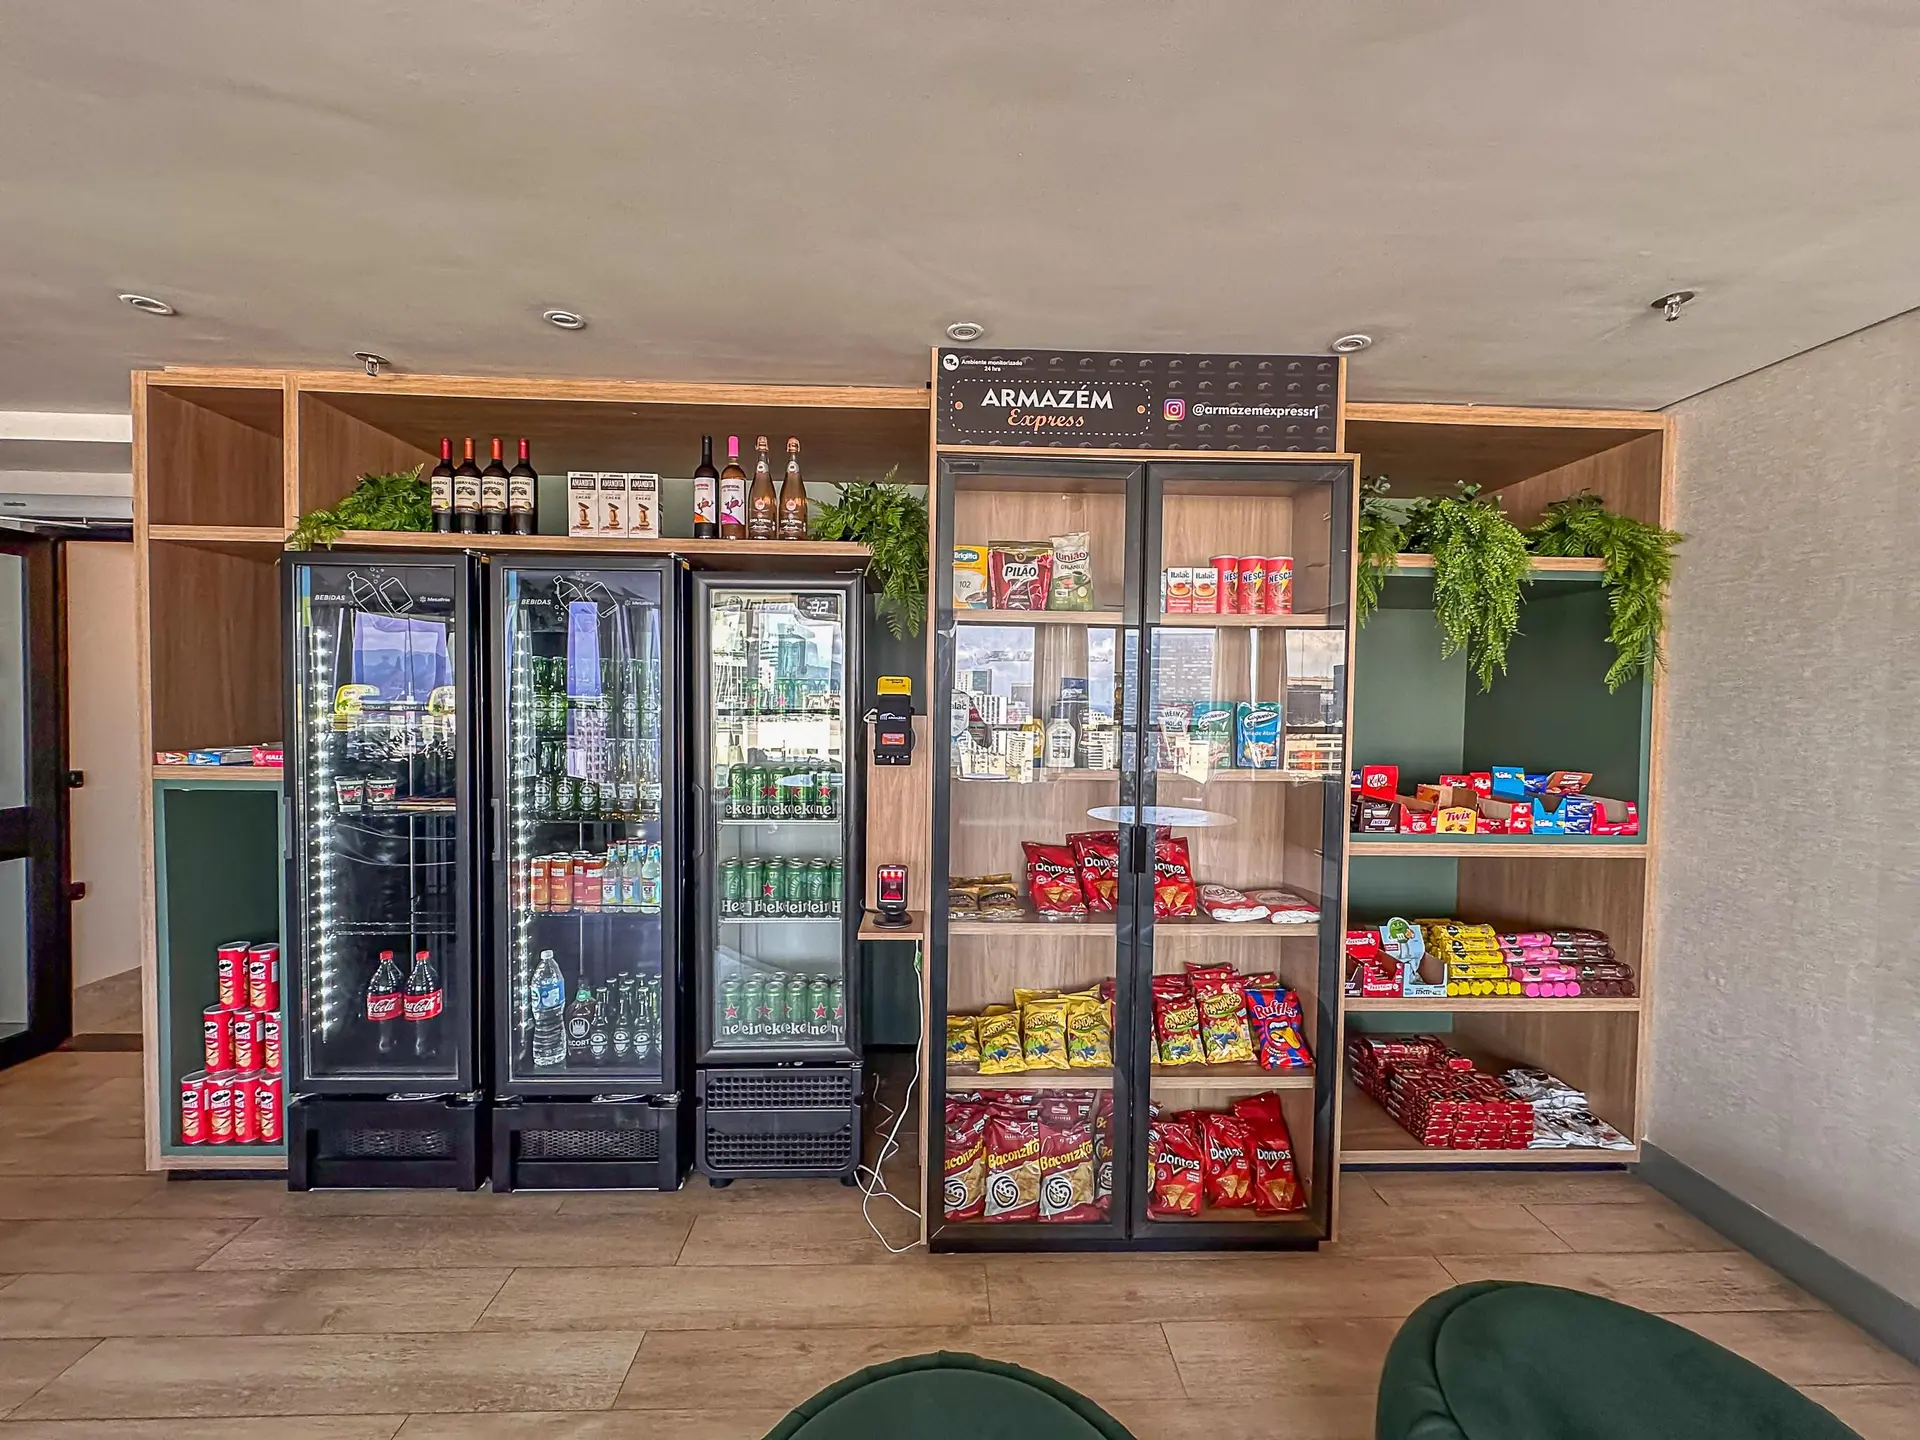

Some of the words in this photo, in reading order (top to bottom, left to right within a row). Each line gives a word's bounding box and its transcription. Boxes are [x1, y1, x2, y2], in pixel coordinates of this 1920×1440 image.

[981, 384, 1114, 410] ARMAZÉM
[1192, 403, 1319, 419] @armazemexpressrj
[1007, 408, 1085, 431] Express
[1058, 552, 1086, 562] união
[1004, 565, 1037, 577] PILÃO
[521, 598, 551, 606] BEBIDAS
[1445, 811, 1471, 821] Twix
[1035, 862, 1074, 874] Doritos
[1253, 1000, 1298, 1020] Ruffles
[1210, 1147, 1244, 1160] Doritos
[1256, 1148, 1292, 1161] Doritos
[1158, 1152, 1200, 1170] Doritos
